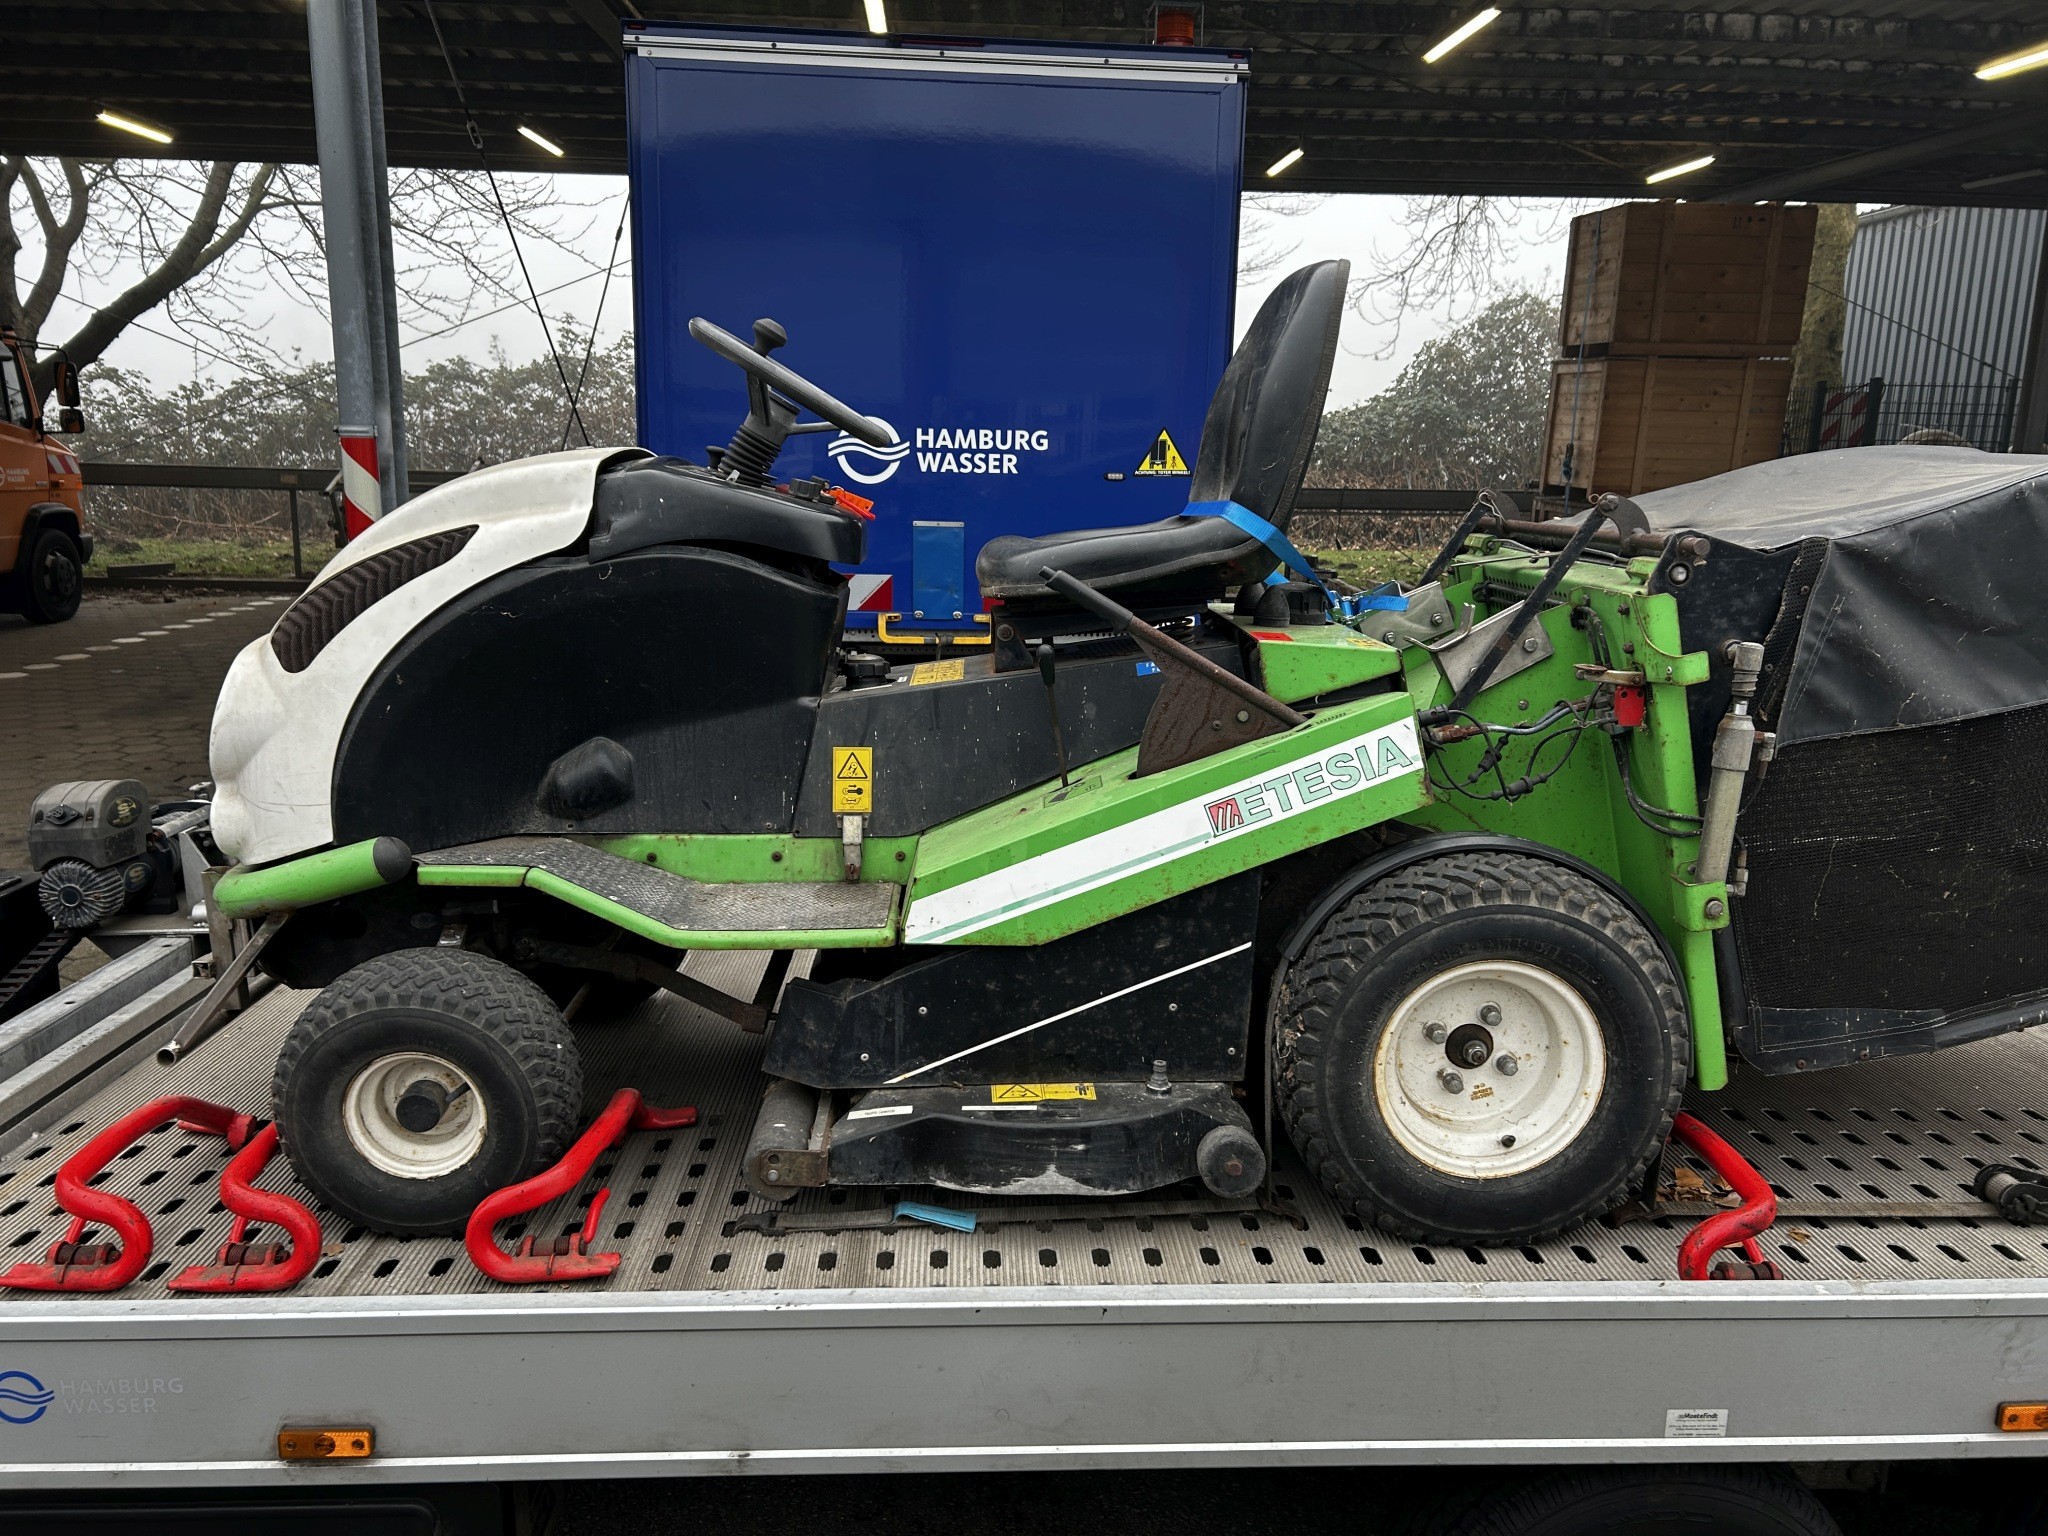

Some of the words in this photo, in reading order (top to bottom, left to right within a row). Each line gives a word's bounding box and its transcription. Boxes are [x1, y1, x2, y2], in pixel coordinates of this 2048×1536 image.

[916, 428, 1049, 451] HAMBURG
[916, 452, 1019, 474] WASSER
[1232, 736, 1414, 822] ETESIA
[60, 1377, 184, 1395] HAMBURG
[64, 1398, 158, 1414] WASSER
